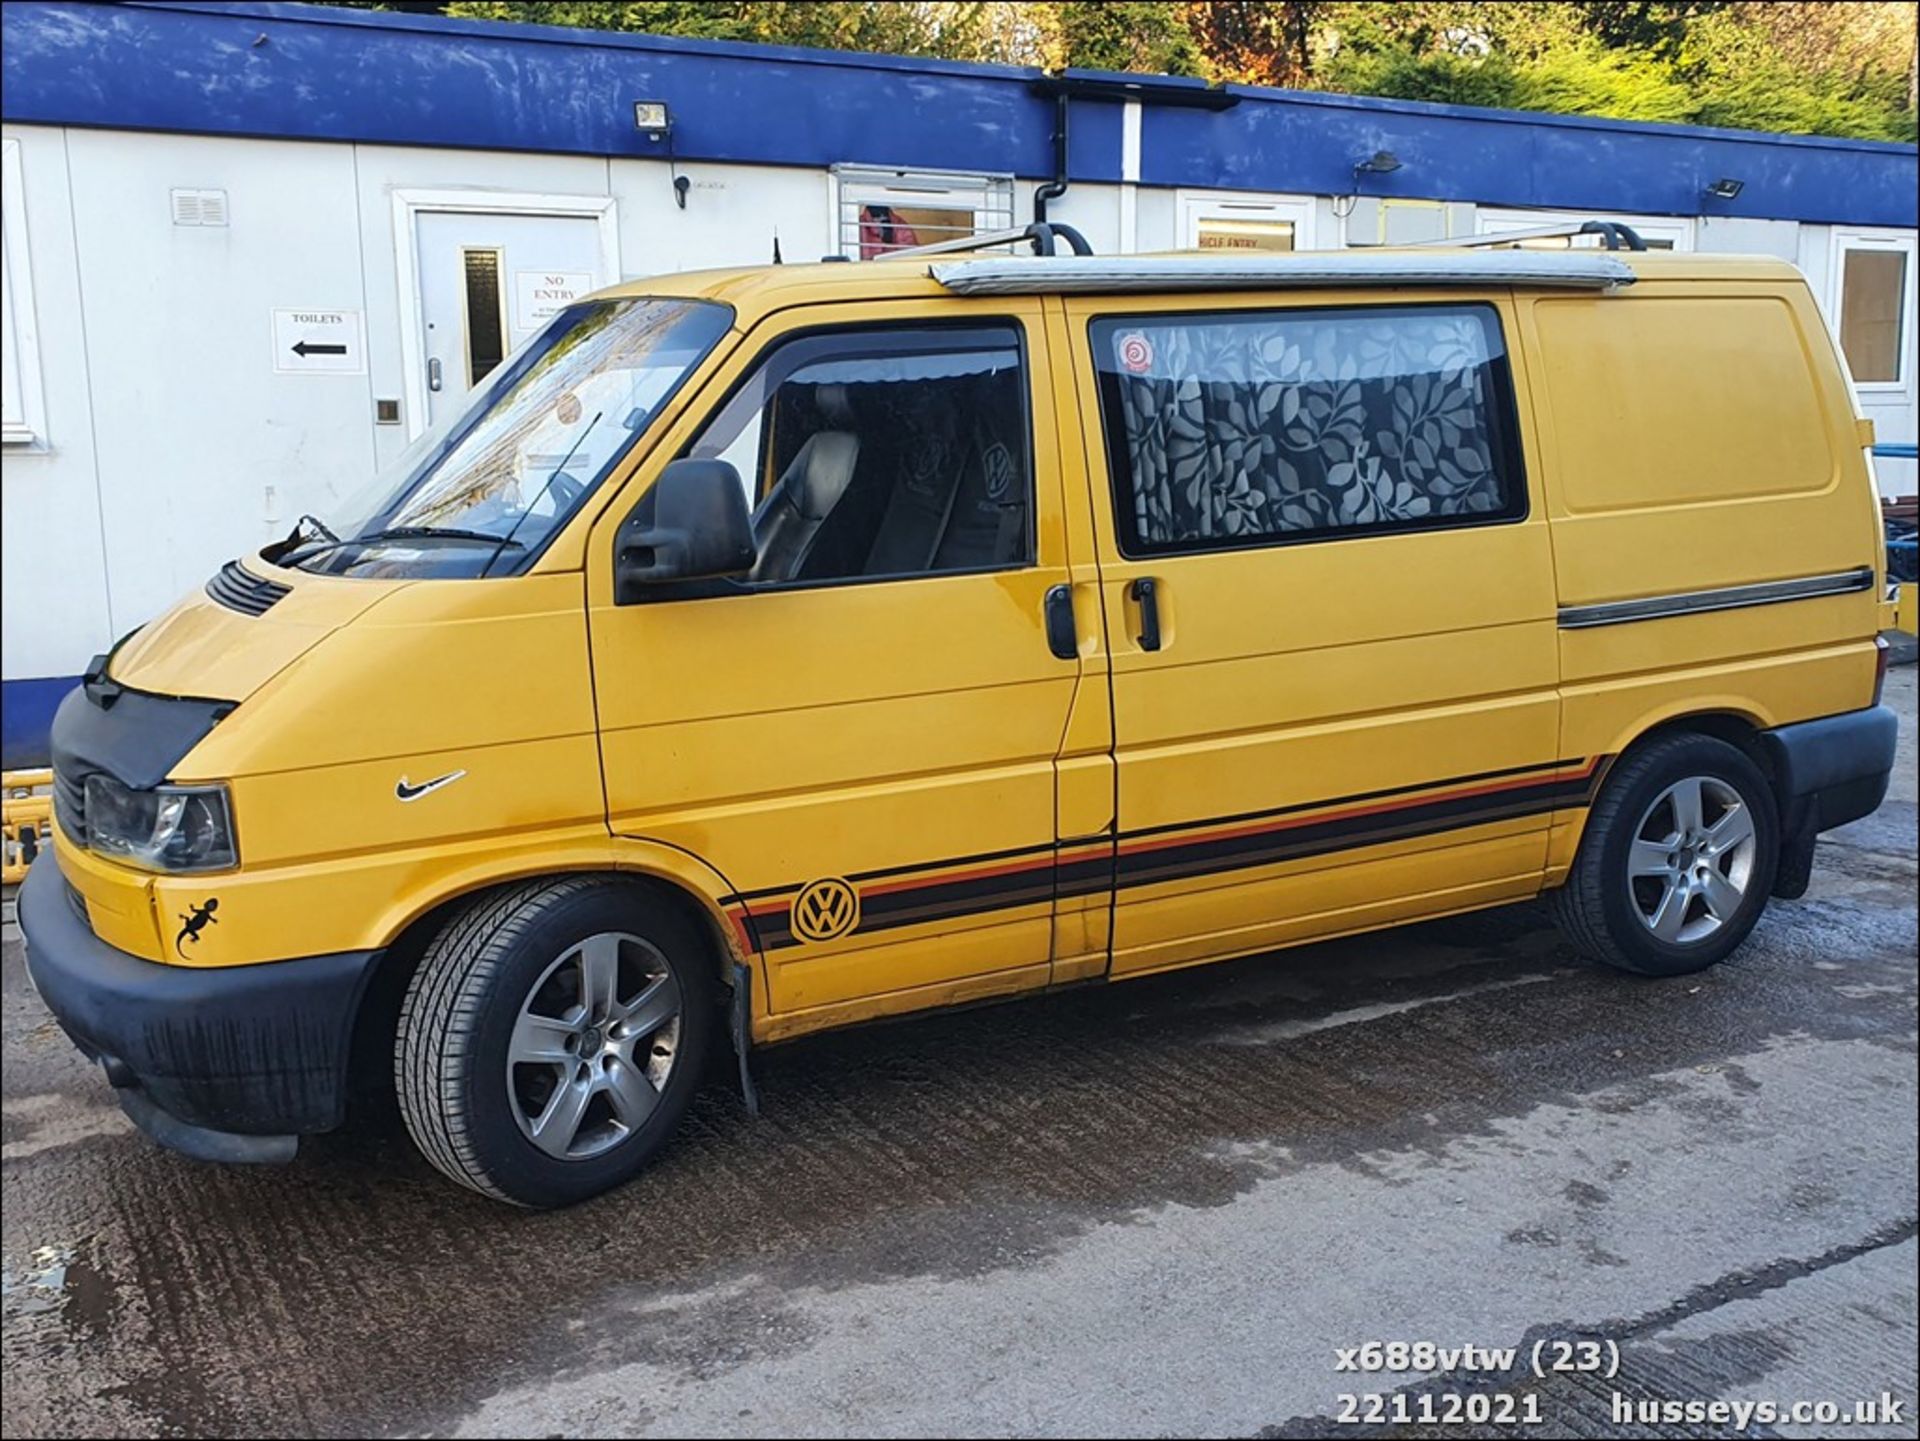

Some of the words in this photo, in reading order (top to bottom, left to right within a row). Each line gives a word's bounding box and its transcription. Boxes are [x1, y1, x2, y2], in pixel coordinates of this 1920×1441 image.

[545, 276, 565, 285] NO
[534, 289, 576, 299] ENTRY
[292, 314, 343, 324] TOILETS
